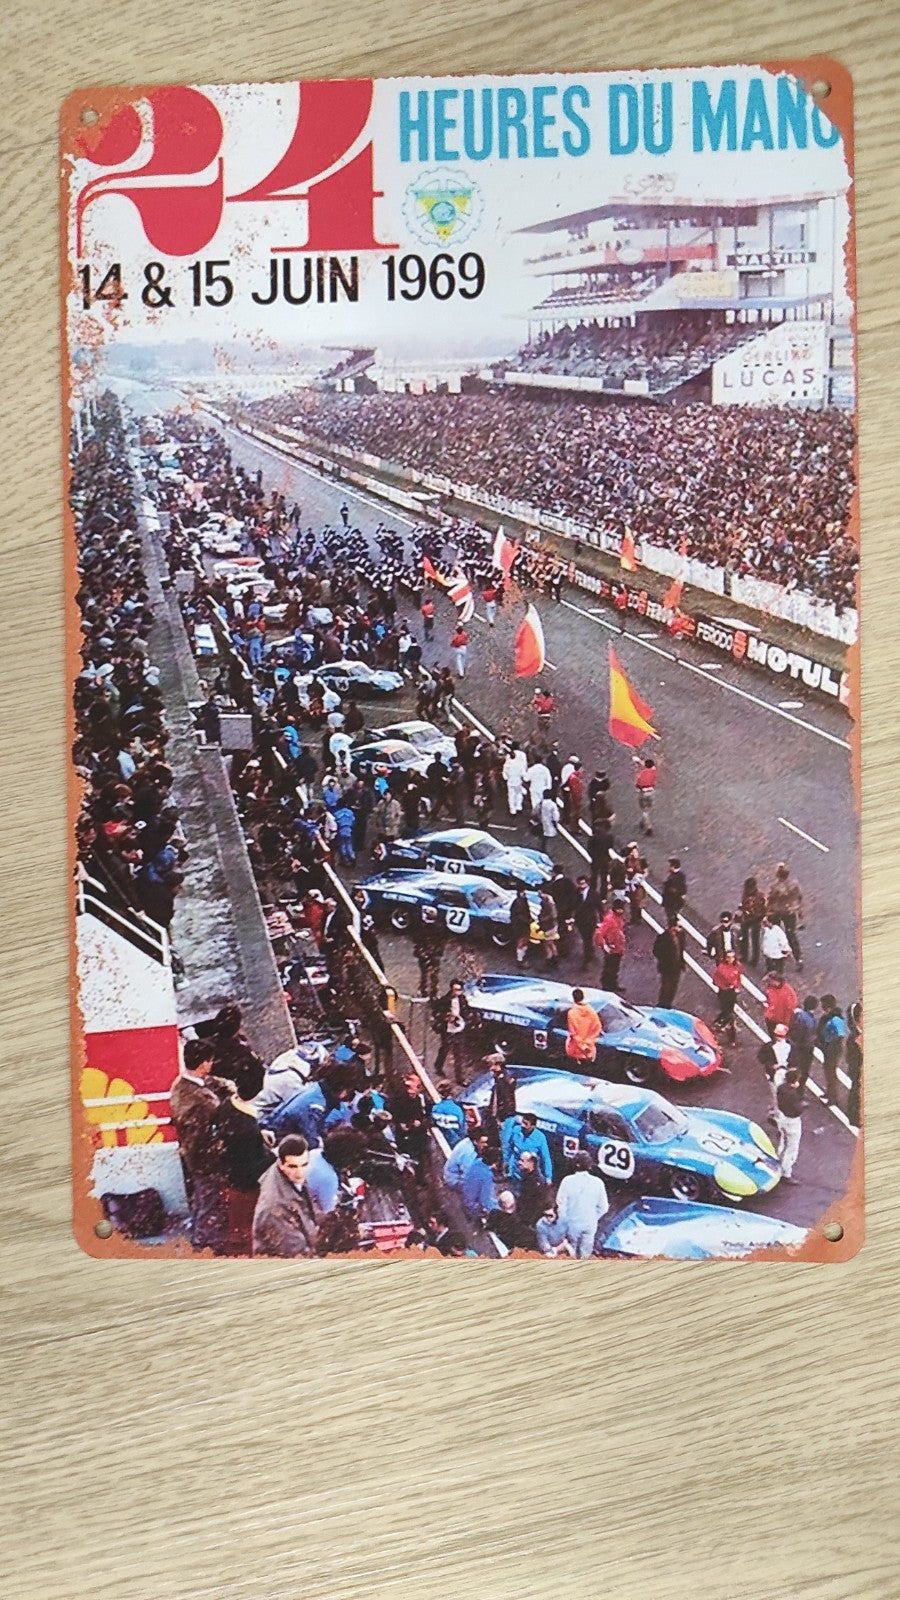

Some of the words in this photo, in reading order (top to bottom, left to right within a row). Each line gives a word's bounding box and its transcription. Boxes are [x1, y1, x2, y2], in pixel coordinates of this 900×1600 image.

[76, 79, 399, 258] 24
[400, 86, 591, 163] HEURES
[609, 81, 673, 155] DU
[78, 262, 128, 310] 14
[141, 261, 176, 308] &
[187, 259, 234, 307] 15
[251, 256, 359, 305] JUIN
[381, 251, 486, 302] 1969
[723, 368, 814, 389] LUCAS
[747, 636, 839, 697] MOTUL
[449, 909, 466, 927] 27
[604, 1143, 631, 1171] 29
